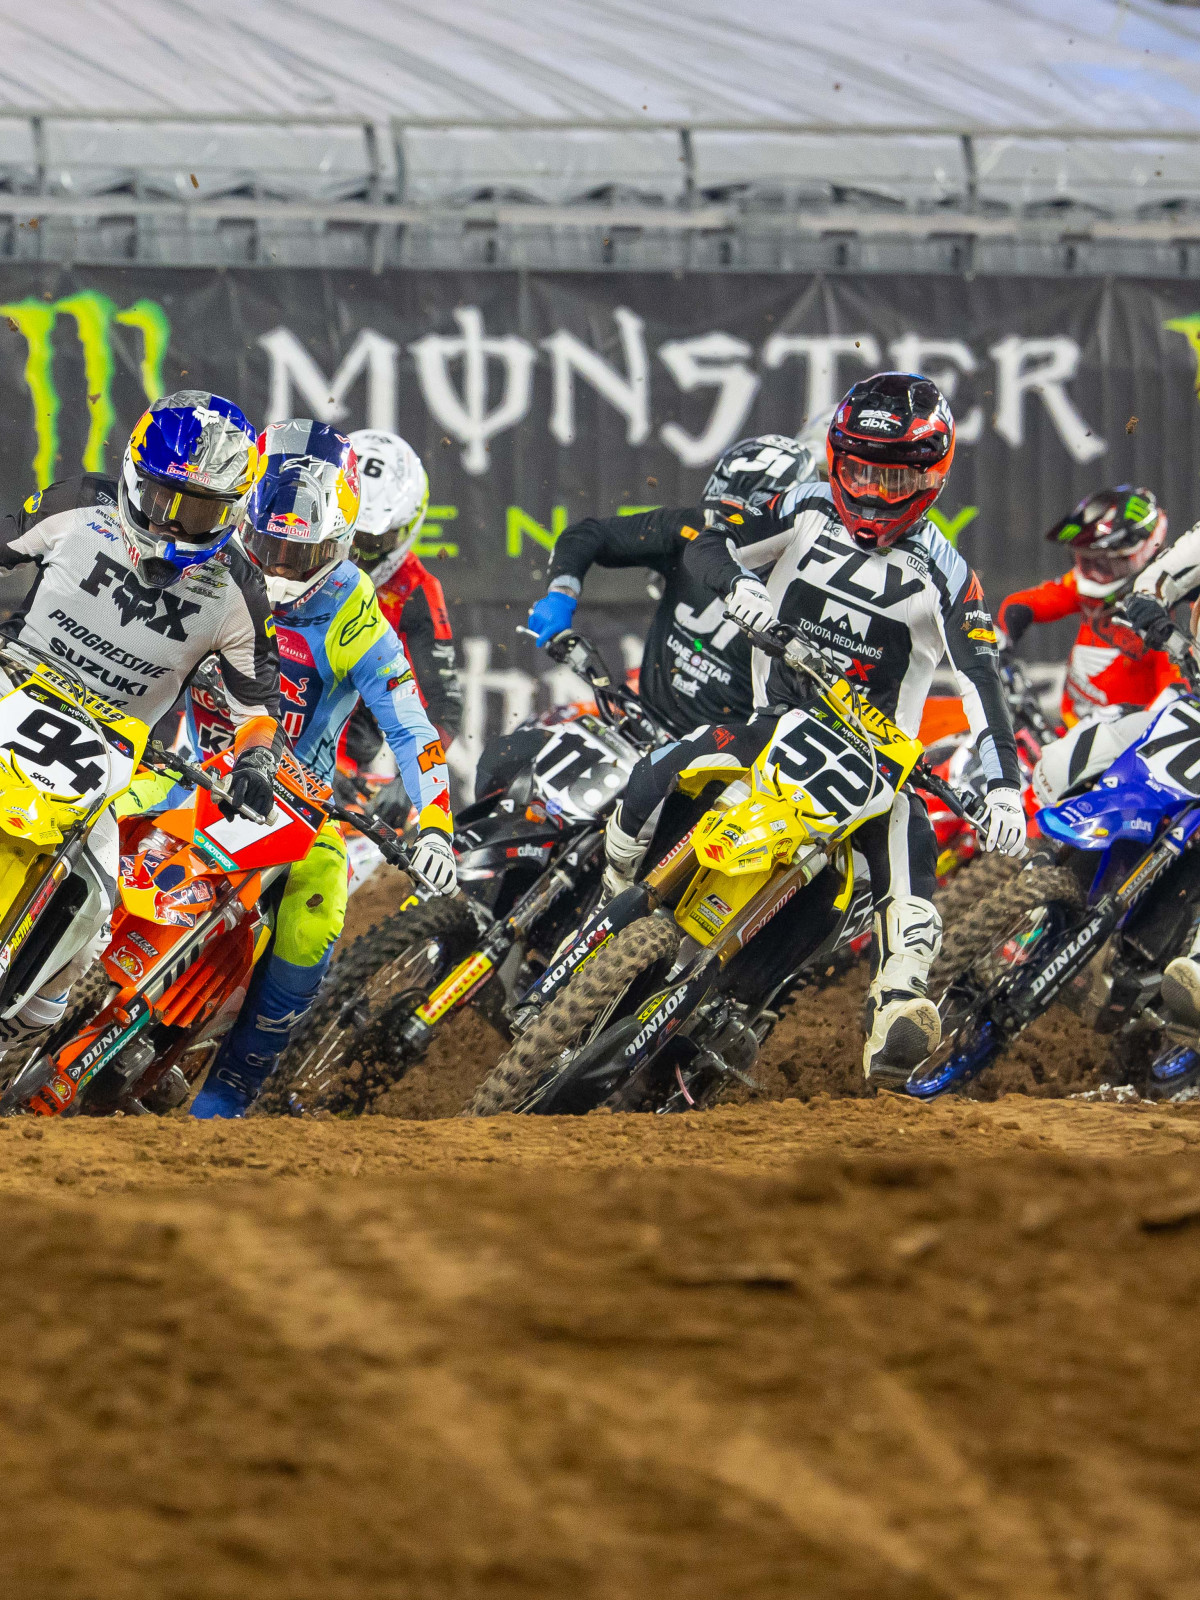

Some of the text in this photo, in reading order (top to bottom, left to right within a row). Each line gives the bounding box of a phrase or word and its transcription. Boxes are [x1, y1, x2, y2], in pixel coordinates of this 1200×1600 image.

[860, 418, 892, 432] dbk.
[167, 465, 210, 485] Red Bull
[95, 508, 122, 529] BREITLIN
[267, 522, 310, 539] Red Bull
[796, 534, 926, 609] FLY
[48, 608, 175, 679] PROGRESSIVE
[800, 617, 883, 660] TOYOTA REDLANDS
[839, 620, 848, 631] R
[49, 636, 149, 697] SUZUKI
[666, 634, 694, 662] LONE
[698, 659, 732, 686] STAR
[0, 708, 107, 796] 94
[841, 726, 872, 757] MONSTER
[29, 771, 56, 790] SKDA
[767, 716, 885, 822] 52
[272, 779, 296, 802] ONSTER
[203, 840, 234, 870] MOTOREX
[11, 912, 34, 950] ACTIVE
[541, 916, 613, 994] DUNLOP
[1030, 916, 1103, 997] DUNLOP
[81, 1003, 141, 1069] DUNLP
